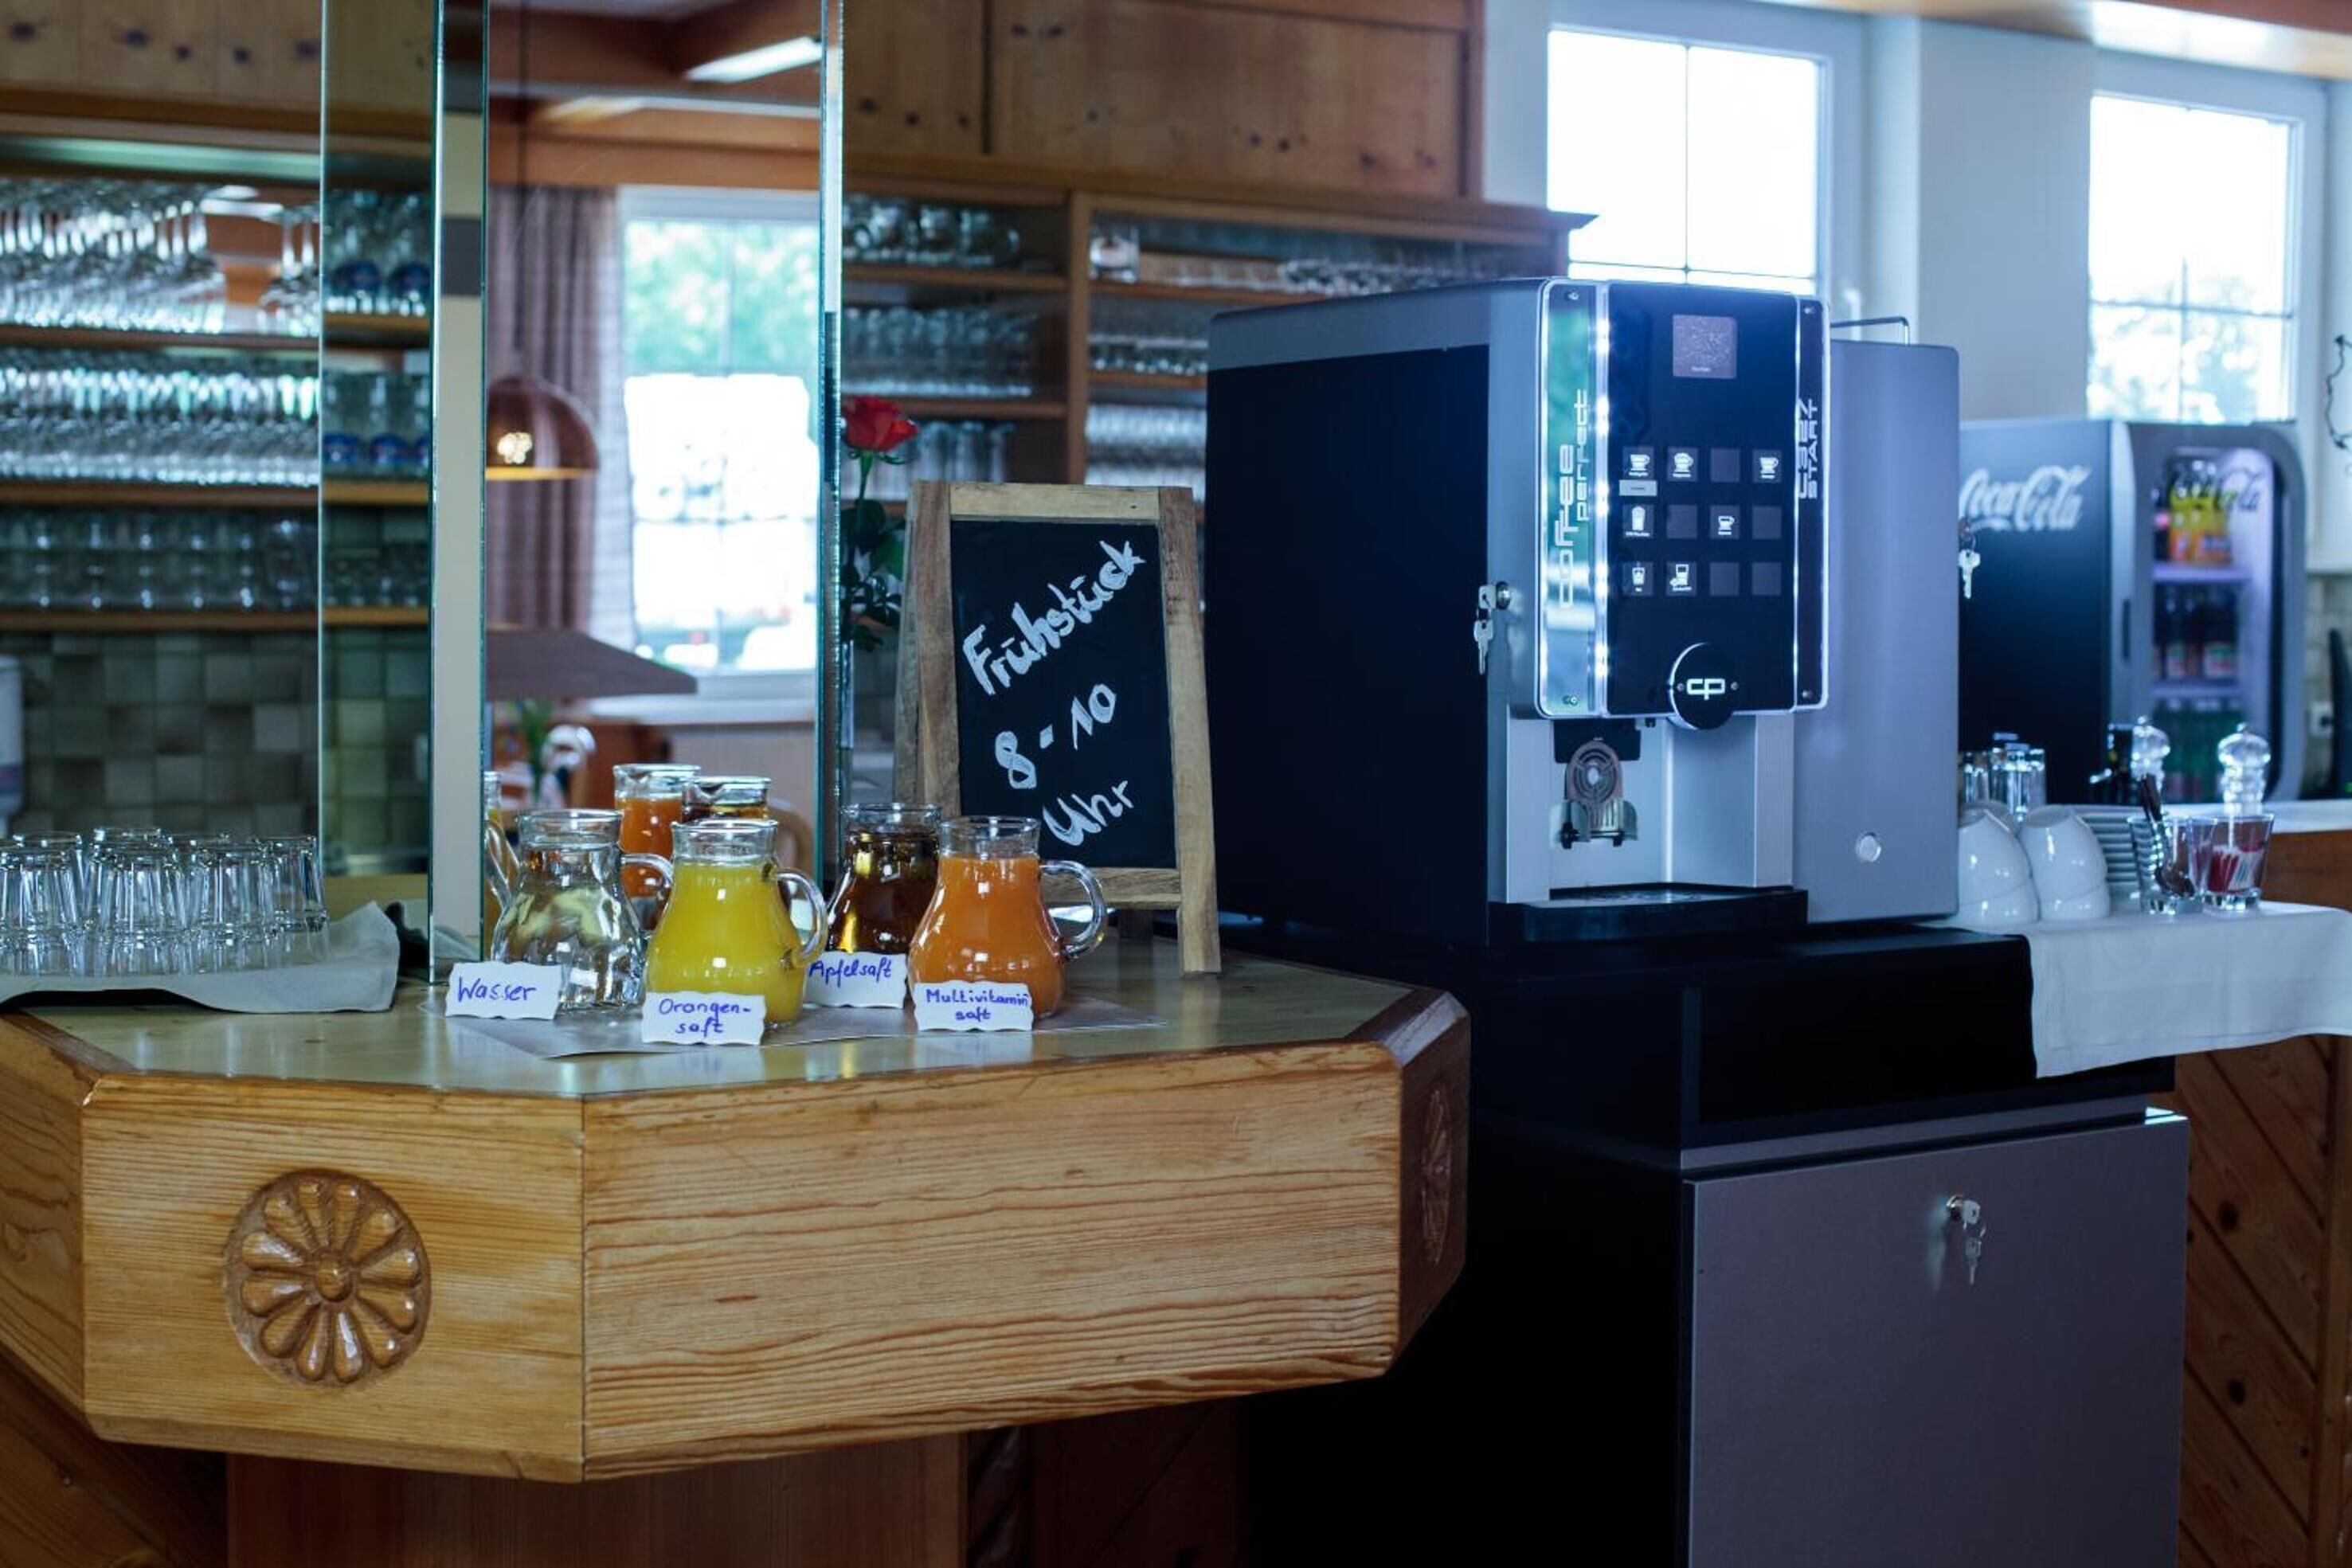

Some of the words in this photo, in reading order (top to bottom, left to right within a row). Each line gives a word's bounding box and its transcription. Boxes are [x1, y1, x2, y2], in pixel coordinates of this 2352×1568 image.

[1573, 389, 1591, 522] perfect
[1808, 399, 1818, 499] START
[1555, 444, 1579, 608] coffee
[962, 540, 1147, 696] Frühstück
[995, 730, 1037, 789] 8
[1070, 683, 1117, 750] 10
[1042, 780, 1134, 846] Uhr
[457, 976, 537, 1003] Wasser
[808, 956, 892, 988] Apfelsaft
[659, 998, 751, 1023] Orangen-
[925, 988, 1029, 1007] Multivitamin
[955, 1006, 992, 1023] saft
[675, 1016, 725, 1038] saft
